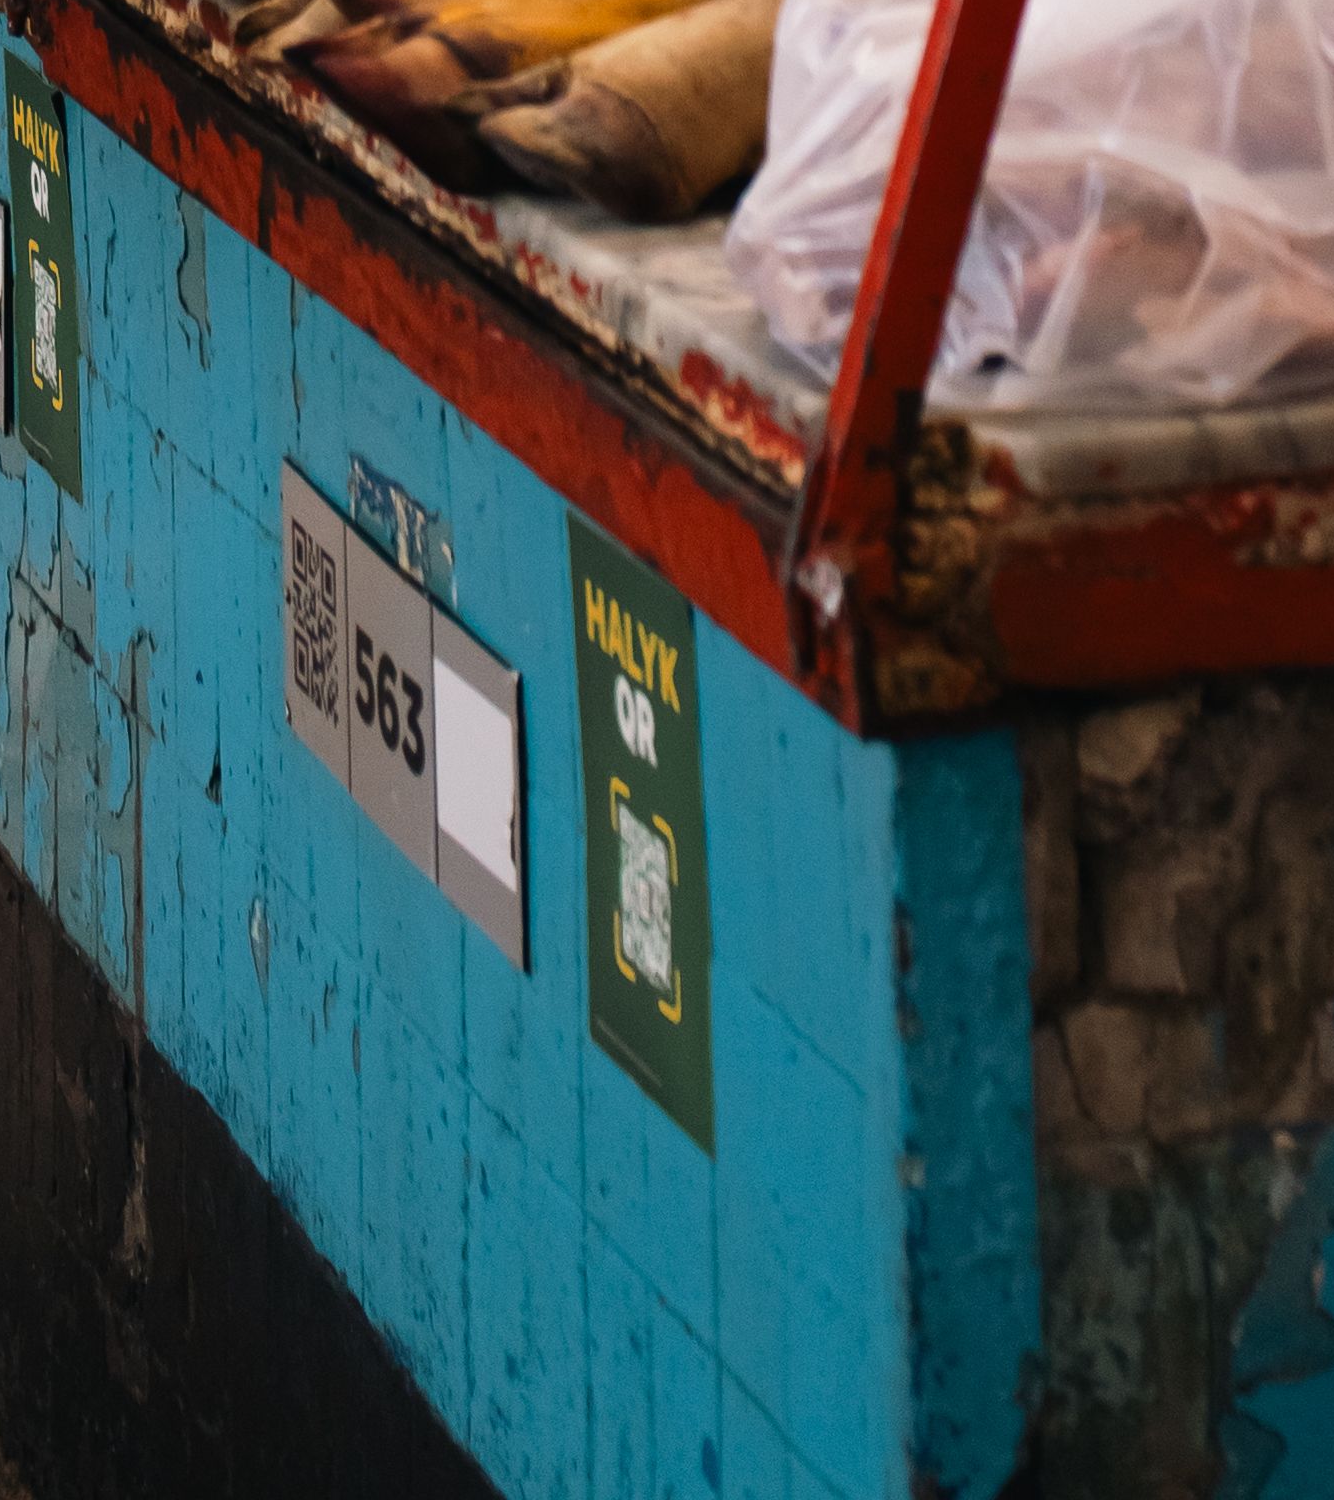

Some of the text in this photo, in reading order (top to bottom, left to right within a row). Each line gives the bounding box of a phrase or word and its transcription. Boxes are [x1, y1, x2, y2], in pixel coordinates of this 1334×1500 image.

[12, 93, 61, 179] HALYK
[30, 159, 51, 224] QR
[585, 577, 681, 715] HALYK
[355, 623, 426, 778] 563
[614, 674, 659, 769] QR
